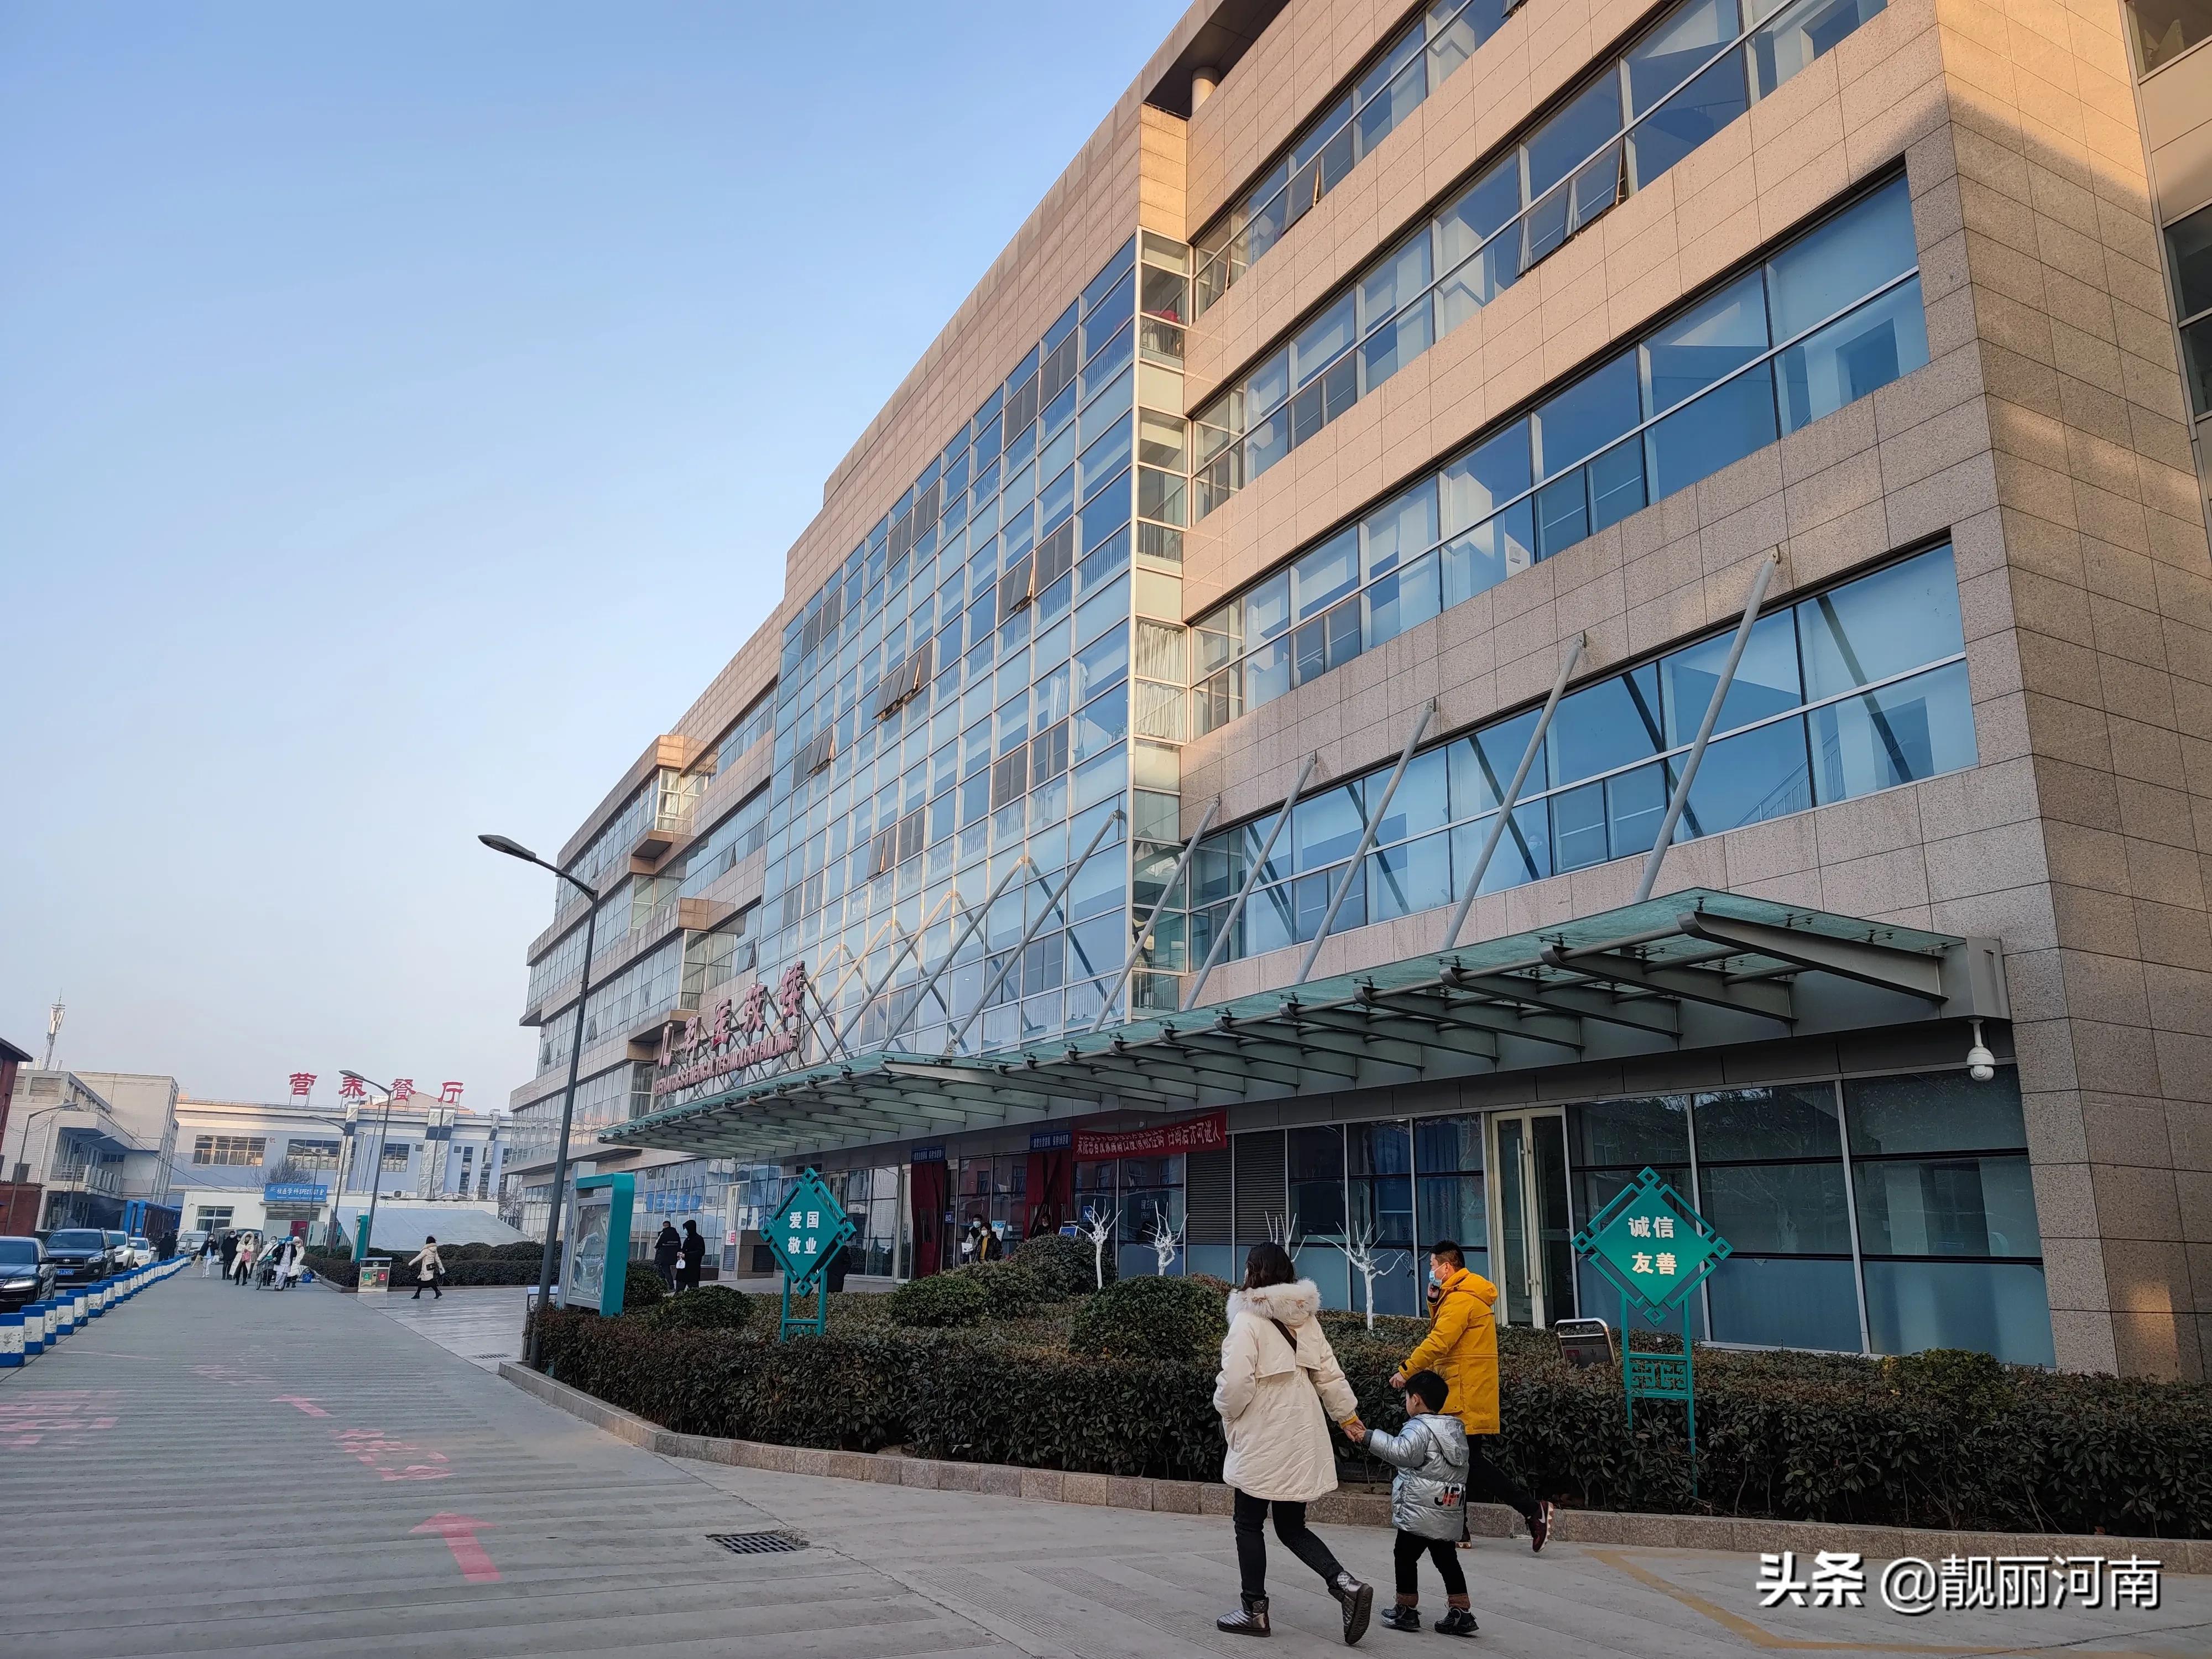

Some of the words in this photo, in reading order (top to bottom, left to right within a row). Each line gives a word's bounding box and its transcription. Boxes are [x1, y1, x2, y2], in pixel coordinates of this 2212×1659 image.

[289, 1071, 464, 1104] 营养餐厅
[789, 1211, 820, 1230] 爱国
[1627, 1215, 1675, 1239] 诚信
[787, 1237, 817, 1255] 敬业
[1631, 1251, 1678, 1275] 友善
